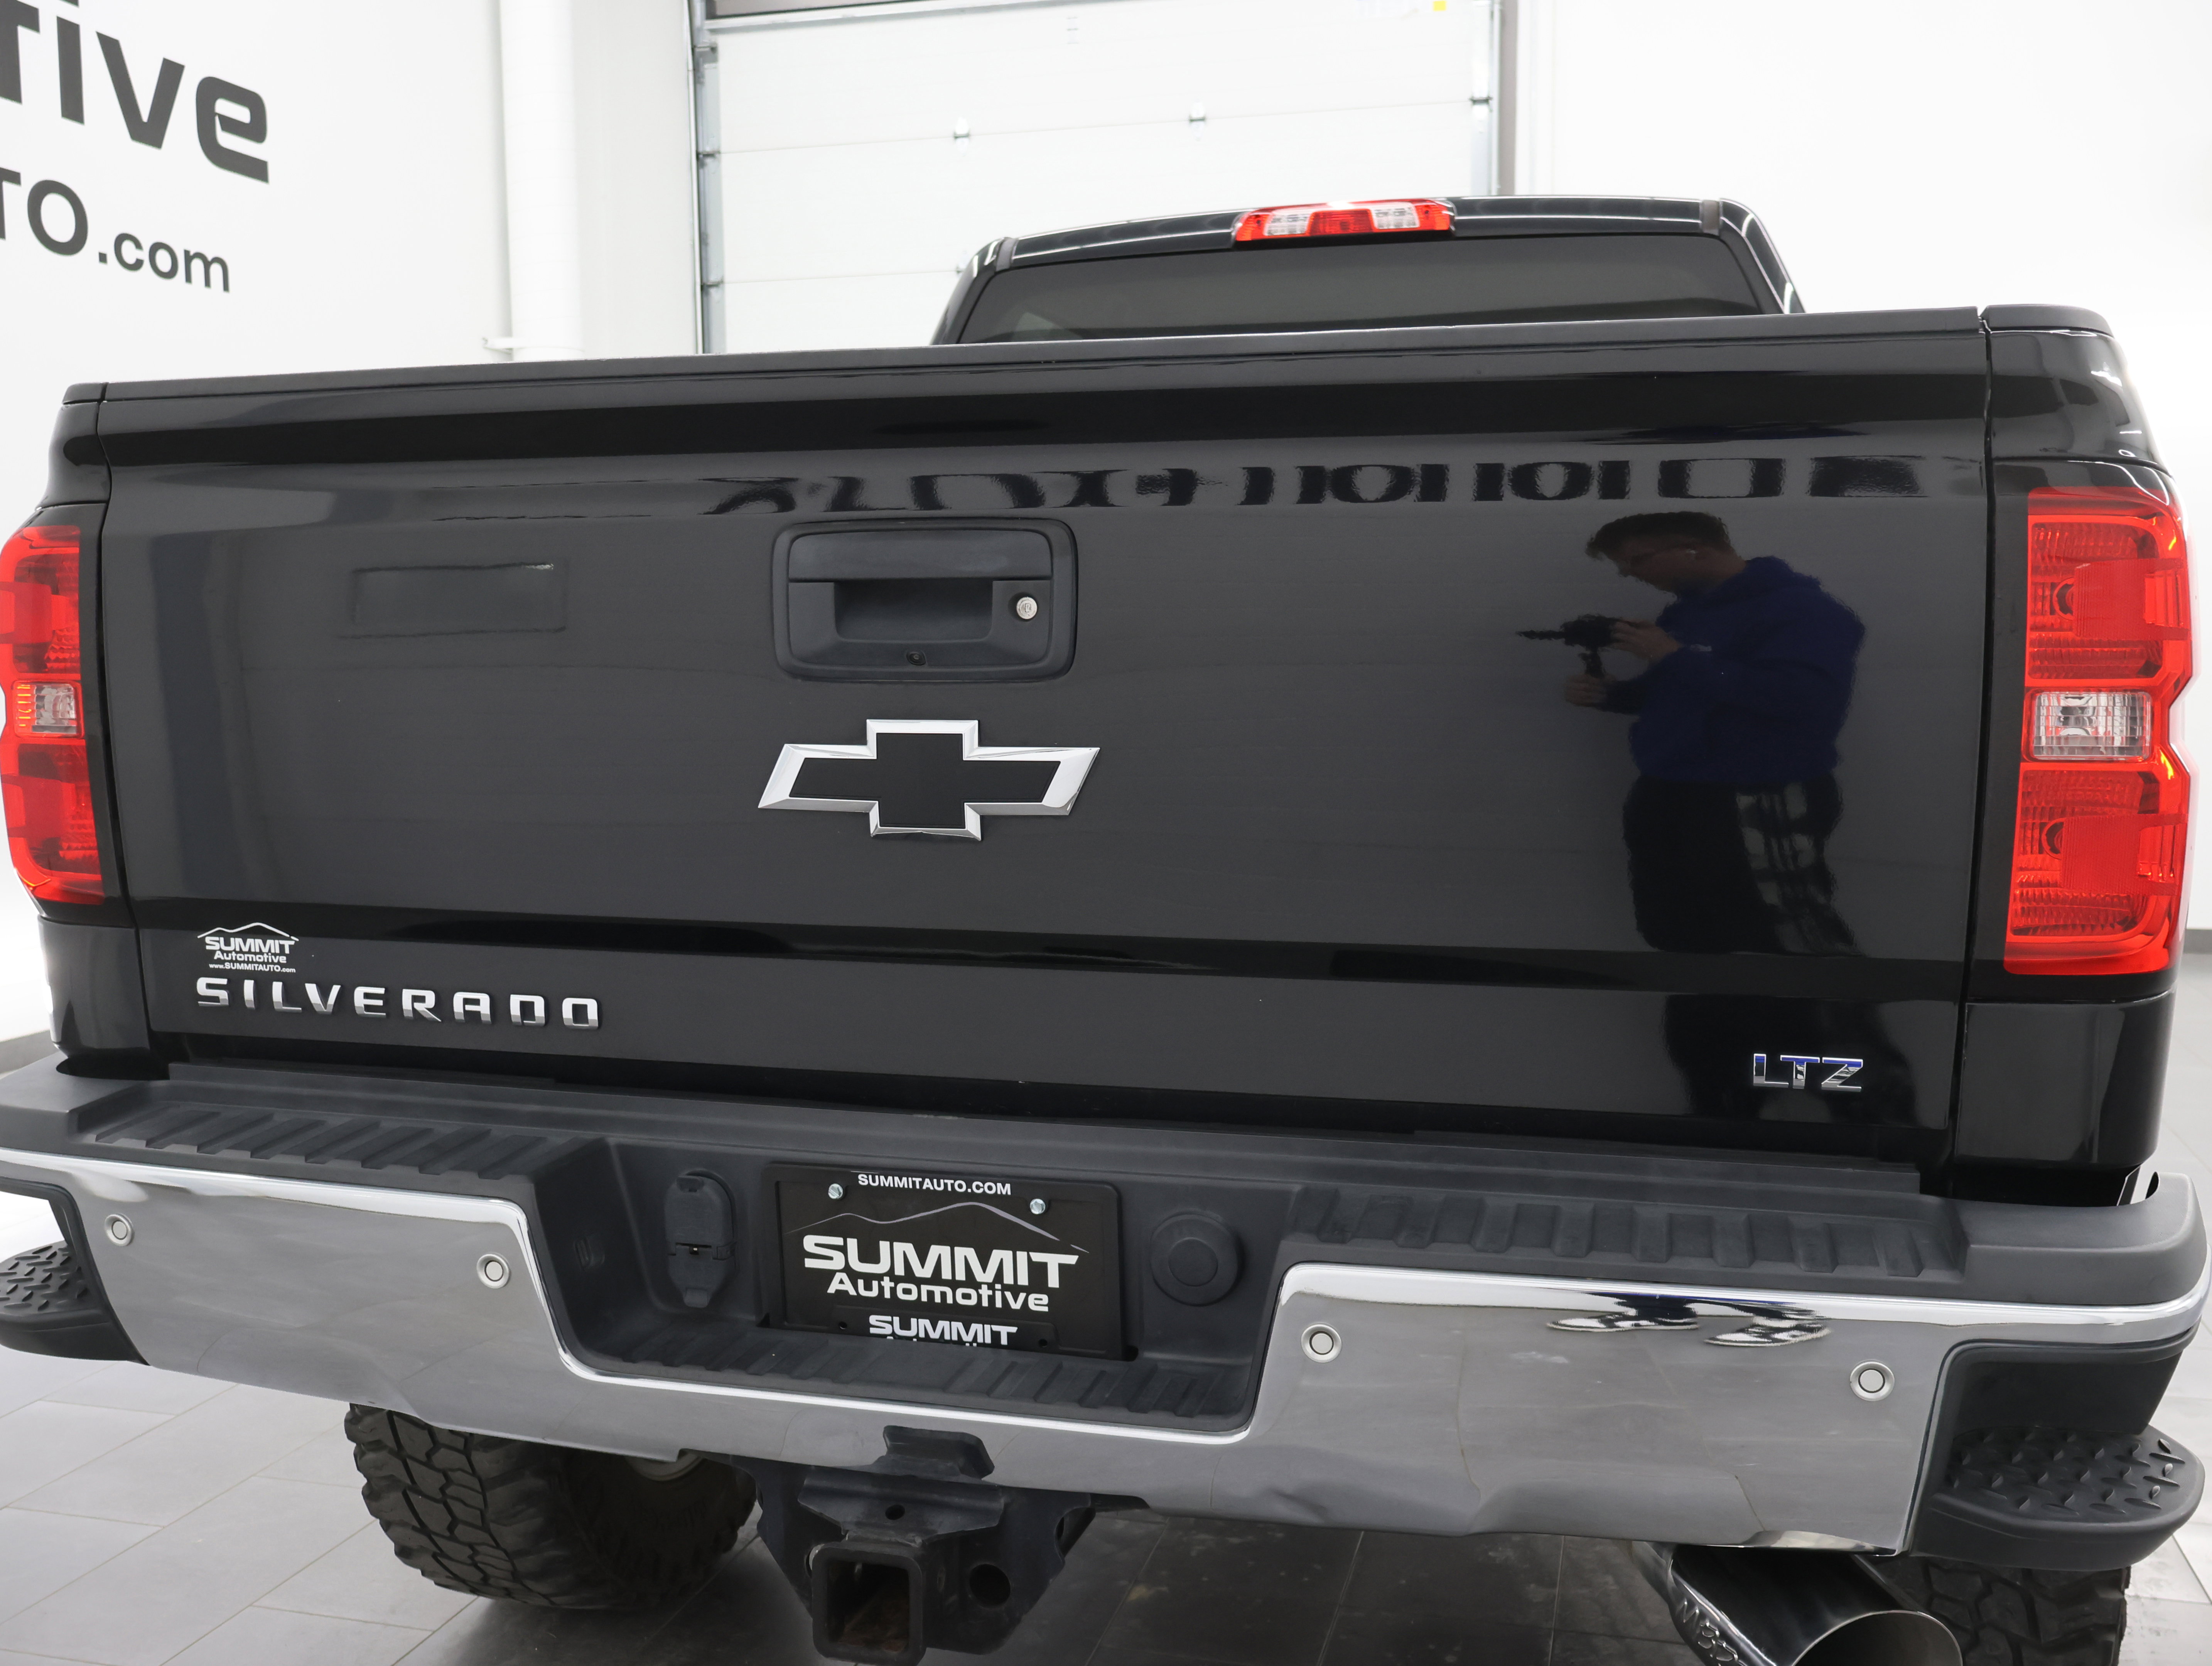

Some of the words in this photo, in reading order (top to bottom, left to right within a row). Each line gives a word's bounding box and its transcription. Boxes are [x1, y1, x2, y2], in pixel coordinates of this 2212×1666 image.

[205, 936, 295, 954] SUMMIT
[214, 950, 287, 963] Automotive
[209, 962, 296, 973] www.SUMMITAUTO.com
[196, 977, 600, 1030] SILVERADO
[1753, 1053, 1864, 1092] LTZ
[858, 1174, 1011, 1195] SUMMITAUTO.COM
[803, 1234, 1079, 1288] SUMMIT
[827, 1272, 1049, 1312] Automotive
[869, 1315, 1018, 1345] SUMMIT
